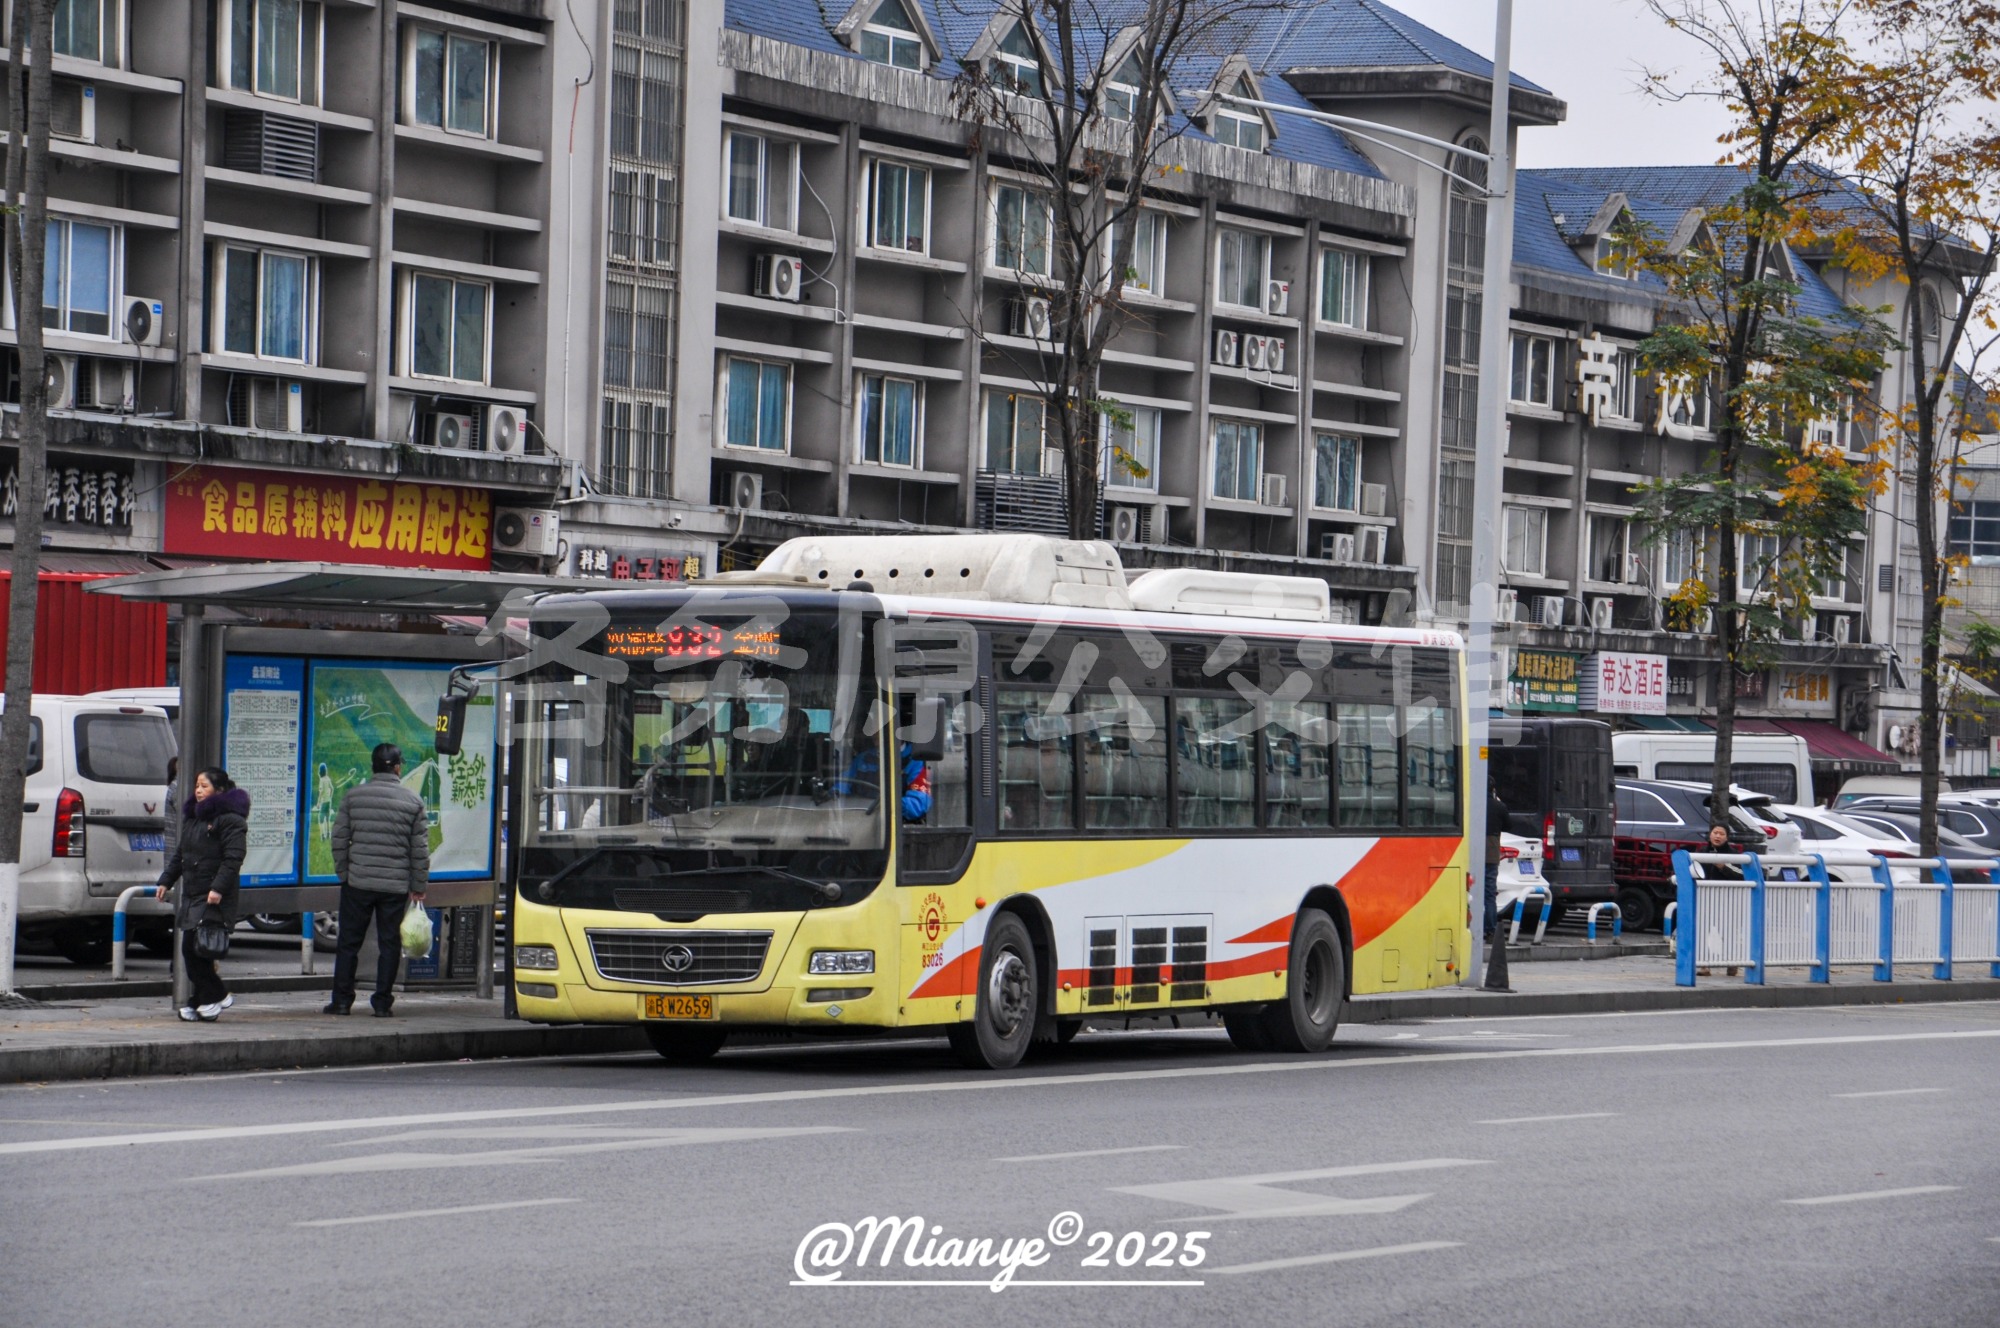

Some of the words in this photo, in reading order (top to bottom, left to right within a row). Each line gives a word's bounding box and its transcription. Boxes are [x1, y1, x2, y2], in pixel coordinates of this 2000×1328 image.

[202, 479, 489, 558] 食品原辅料应用配送
[669, 626, 722, 655] 932
[1423, 633, 1455, 646] 重庆公交
[1603, 656, 1664, 697] 帝达酒店
[436, 715, 449, 733] 32
[450, 775, 487, 810] 新态度
[922, 953, 943, 968] 83026
